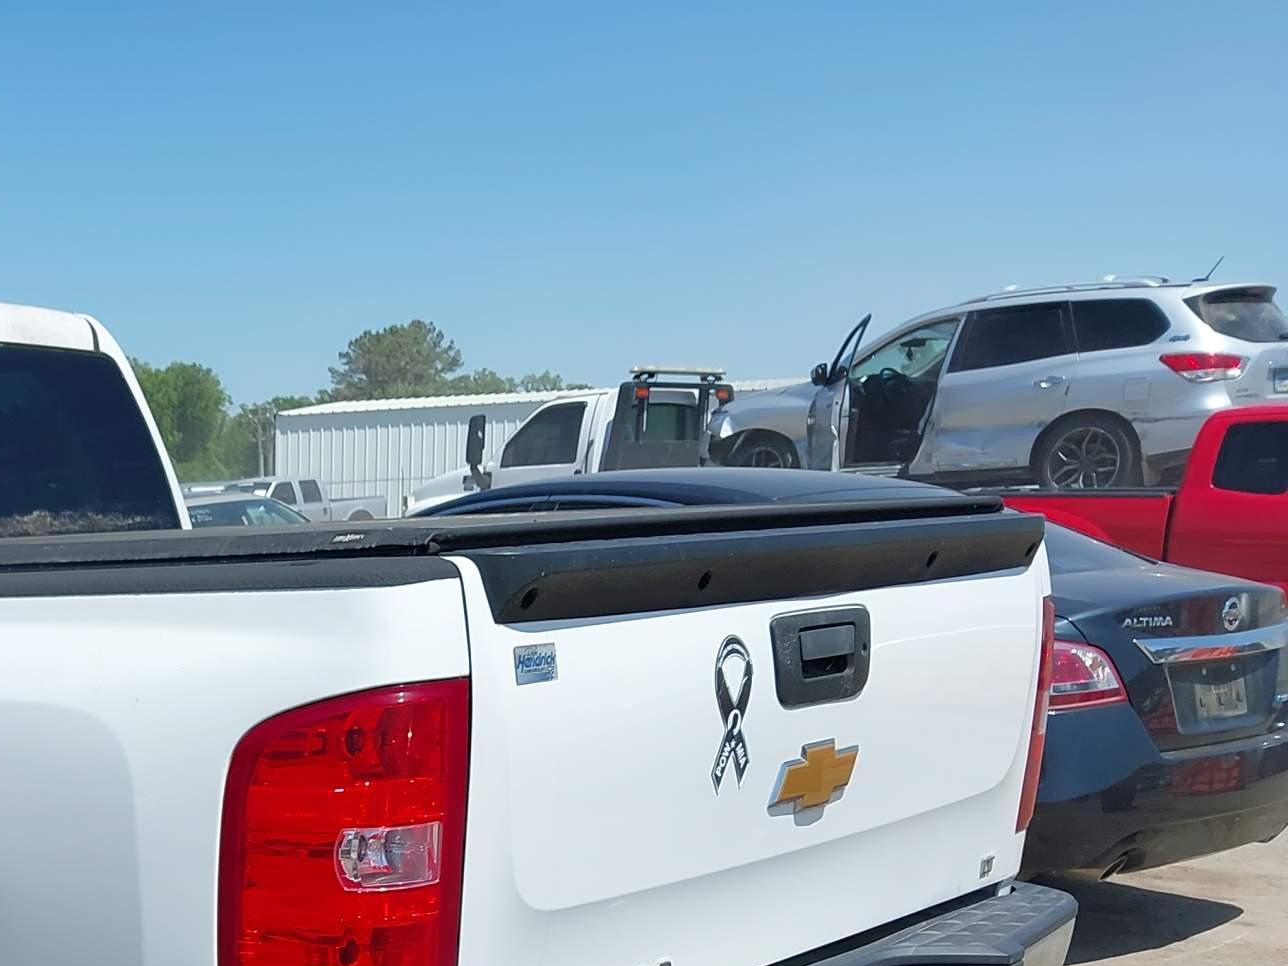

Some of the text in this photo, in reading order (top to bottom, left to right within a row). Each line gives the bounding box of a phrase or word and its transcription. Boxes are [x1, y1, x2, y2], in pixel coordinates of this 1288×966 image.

[1121, 616, 1173, 628] ALTIMA
[715, 741, 731, 777] POW
[735, 742, 747, 769] MIA
